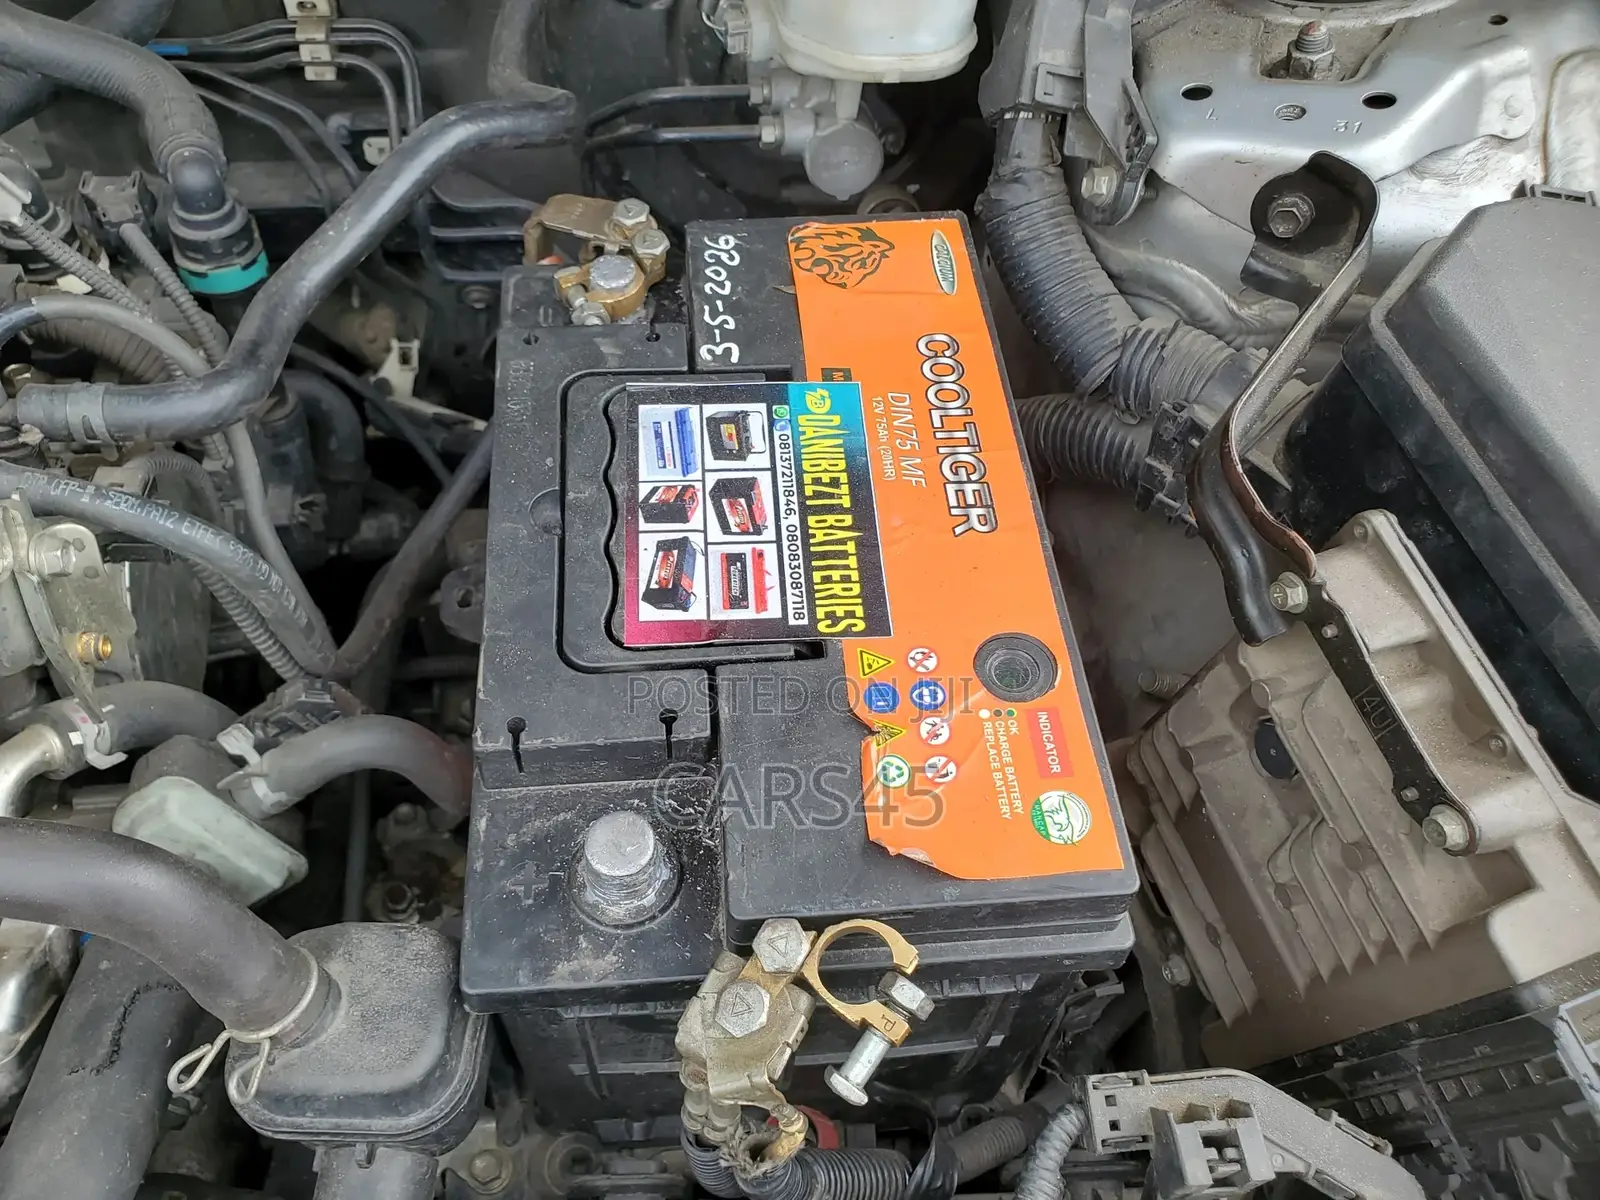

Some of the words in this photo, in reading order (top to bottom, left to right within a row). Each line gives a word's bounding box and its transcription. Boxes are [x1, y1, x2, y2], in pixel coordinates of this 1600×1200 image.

[700, 234, 741, 364] 3-5-2026
[932, 243, 956, 283] CALCIUM
[872, 396, 886, 414] 12V
[875, 417, 889, 442] 75Ah
[887, 392, 920, 451] DIN75
[916, 333, 998, 537] COOLTIGER
[778, 433, 797, 520] 08137211846,
[798, 414, 851, 508] DANIBEZT
[877, 445, 897, 481] (20HR)
[898, 456, 928, 488] MF
[785, 524, 806, 621] 08083087118
[807, 514, 867, 634] BATTERIES
[1007, 719, 1019, 735] OK
[1037, 711, 1061, 774] INDICATOR
[983, 721, 1001, 769] REPLACE
[993, 772, 1012, 819] BATTERY
[995, 720, 1012, 764] CHARGE
[1005, 766, 1024, 814] BATTERY
